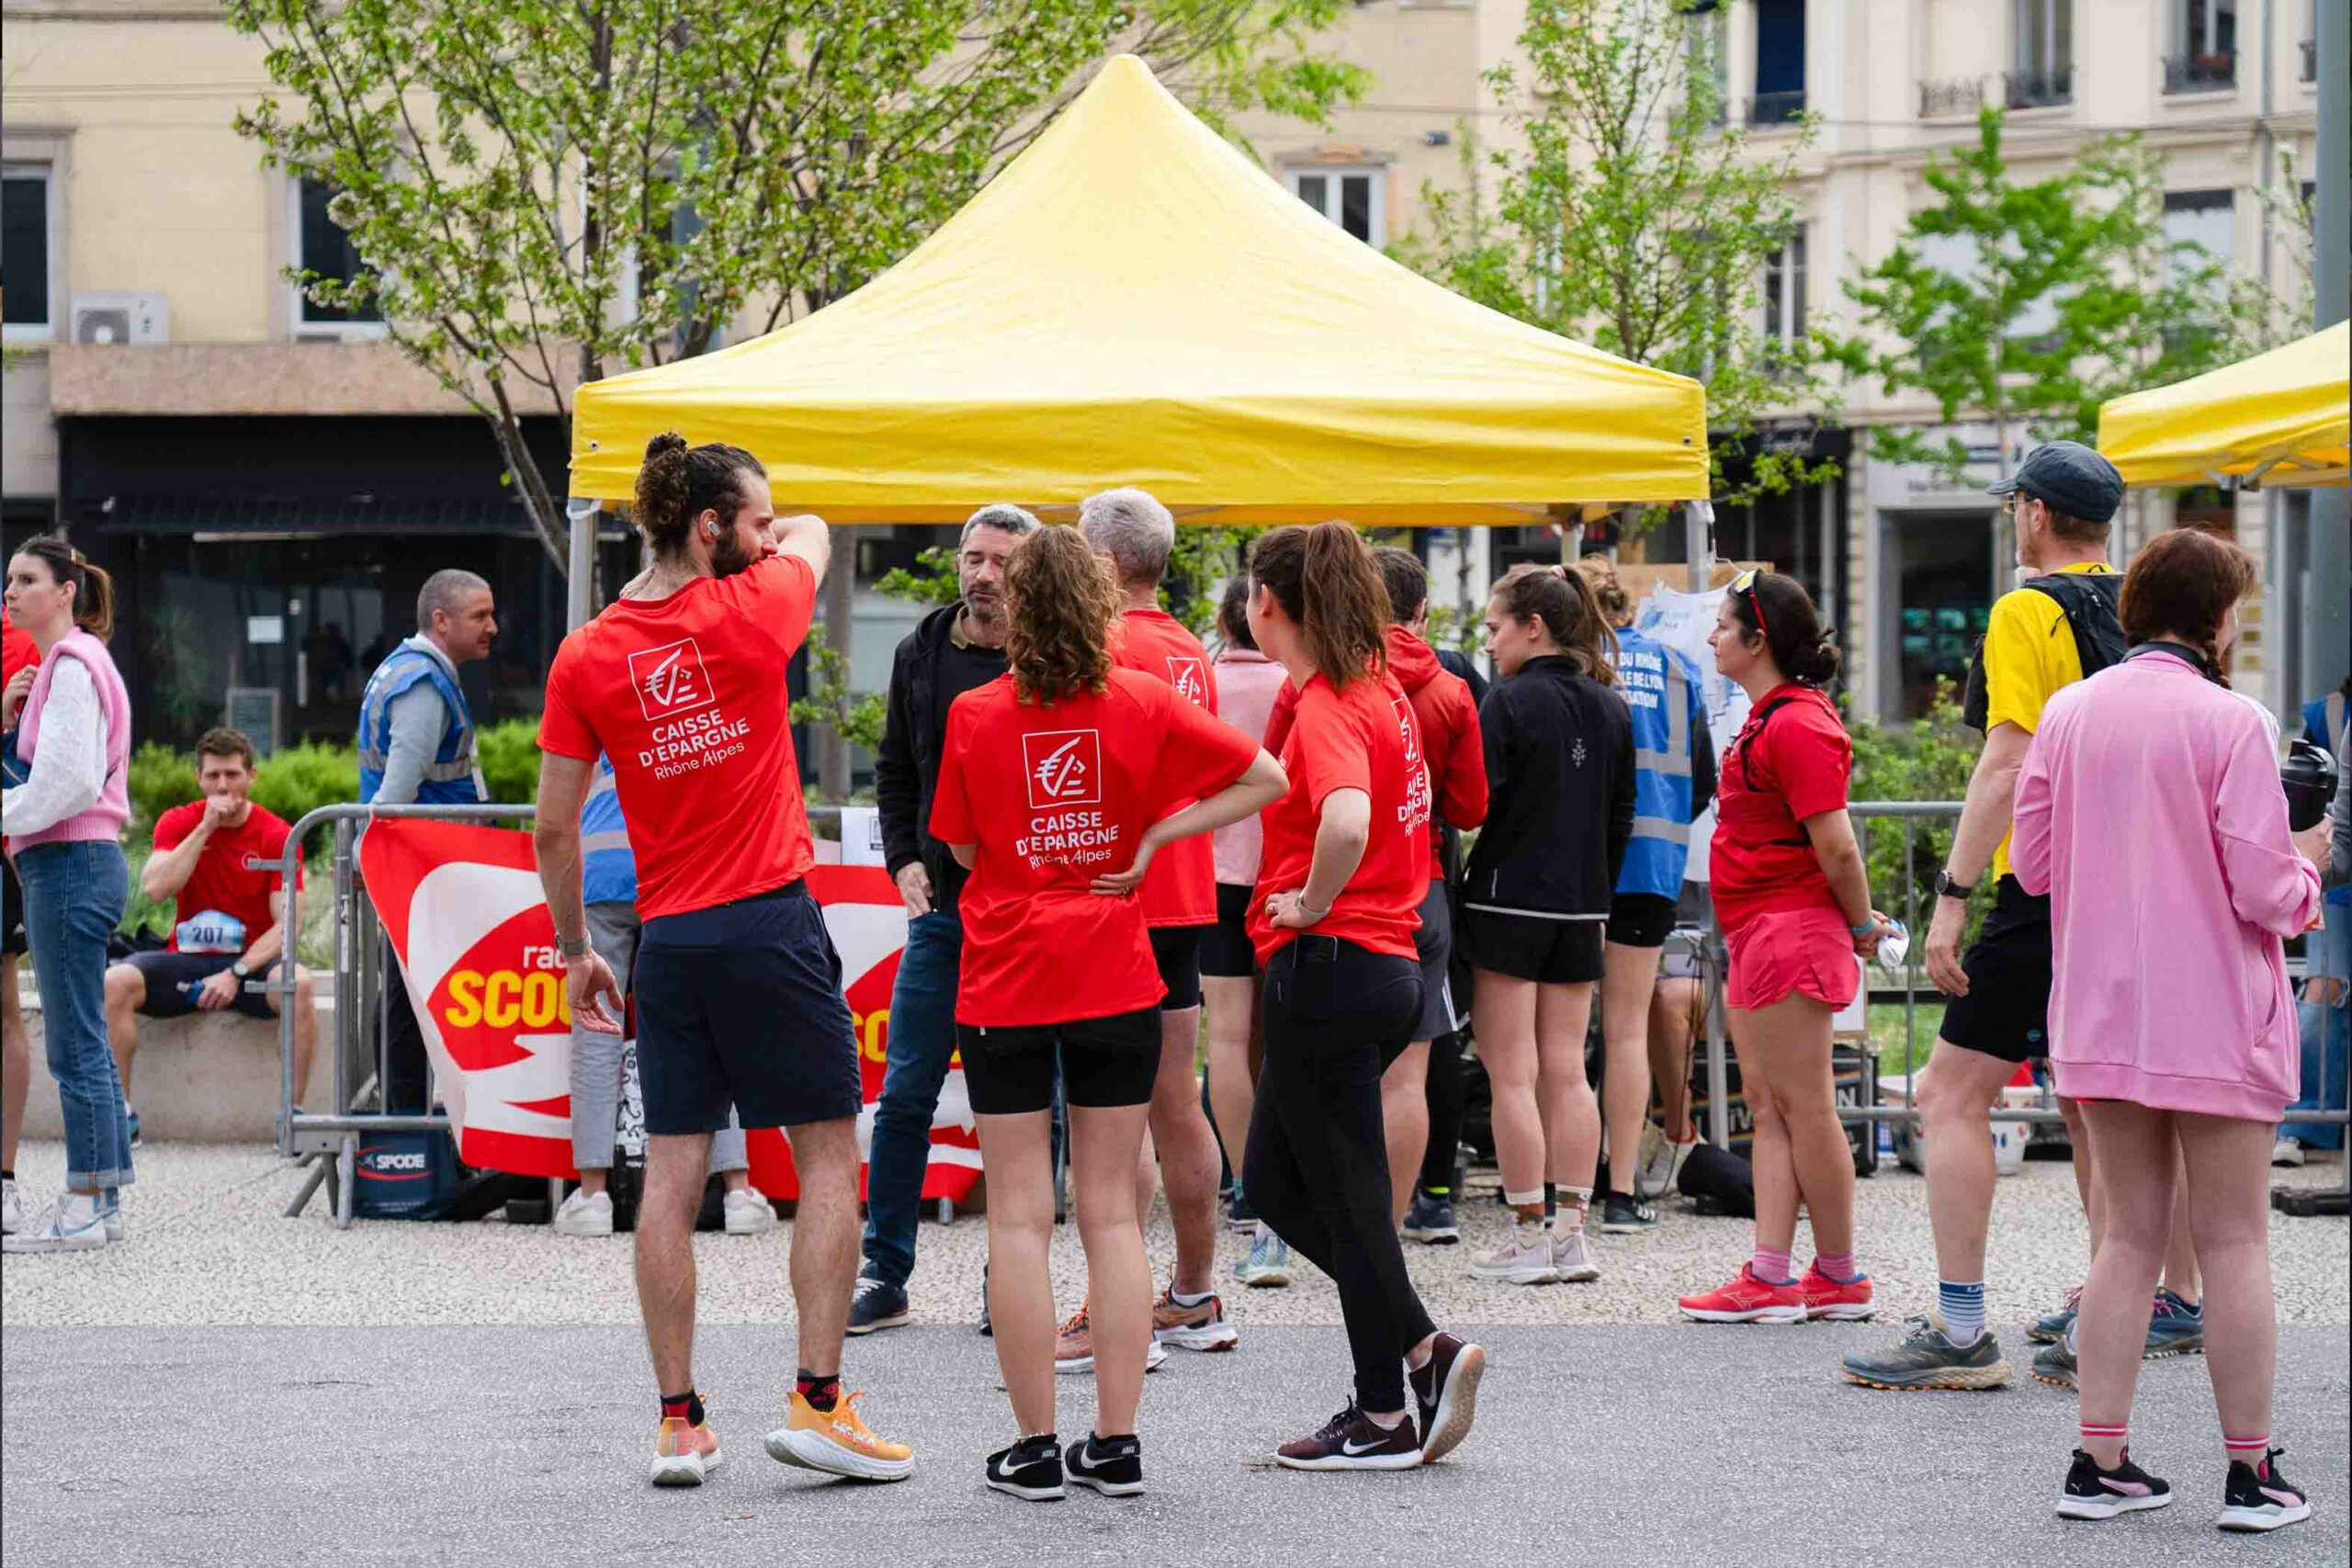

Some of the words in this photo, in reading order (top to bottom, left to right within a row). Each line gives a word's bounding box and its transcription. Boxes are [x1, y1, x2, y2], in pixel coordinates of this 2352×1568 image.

[651, 708, 724, 744] CAISSE
[639, 717, 751, 768] D'EPARGNE
[654, 759, 700, 780] Rhône
[702, 741, 745, 766] Alpes
[1031, 811, 1102, 834] CAISSE
[1015, 824, 1119, 856] D'EPARGNE
[1070, 848, 1112, 865] Alpes
[192, 927, 223, 944] 207
